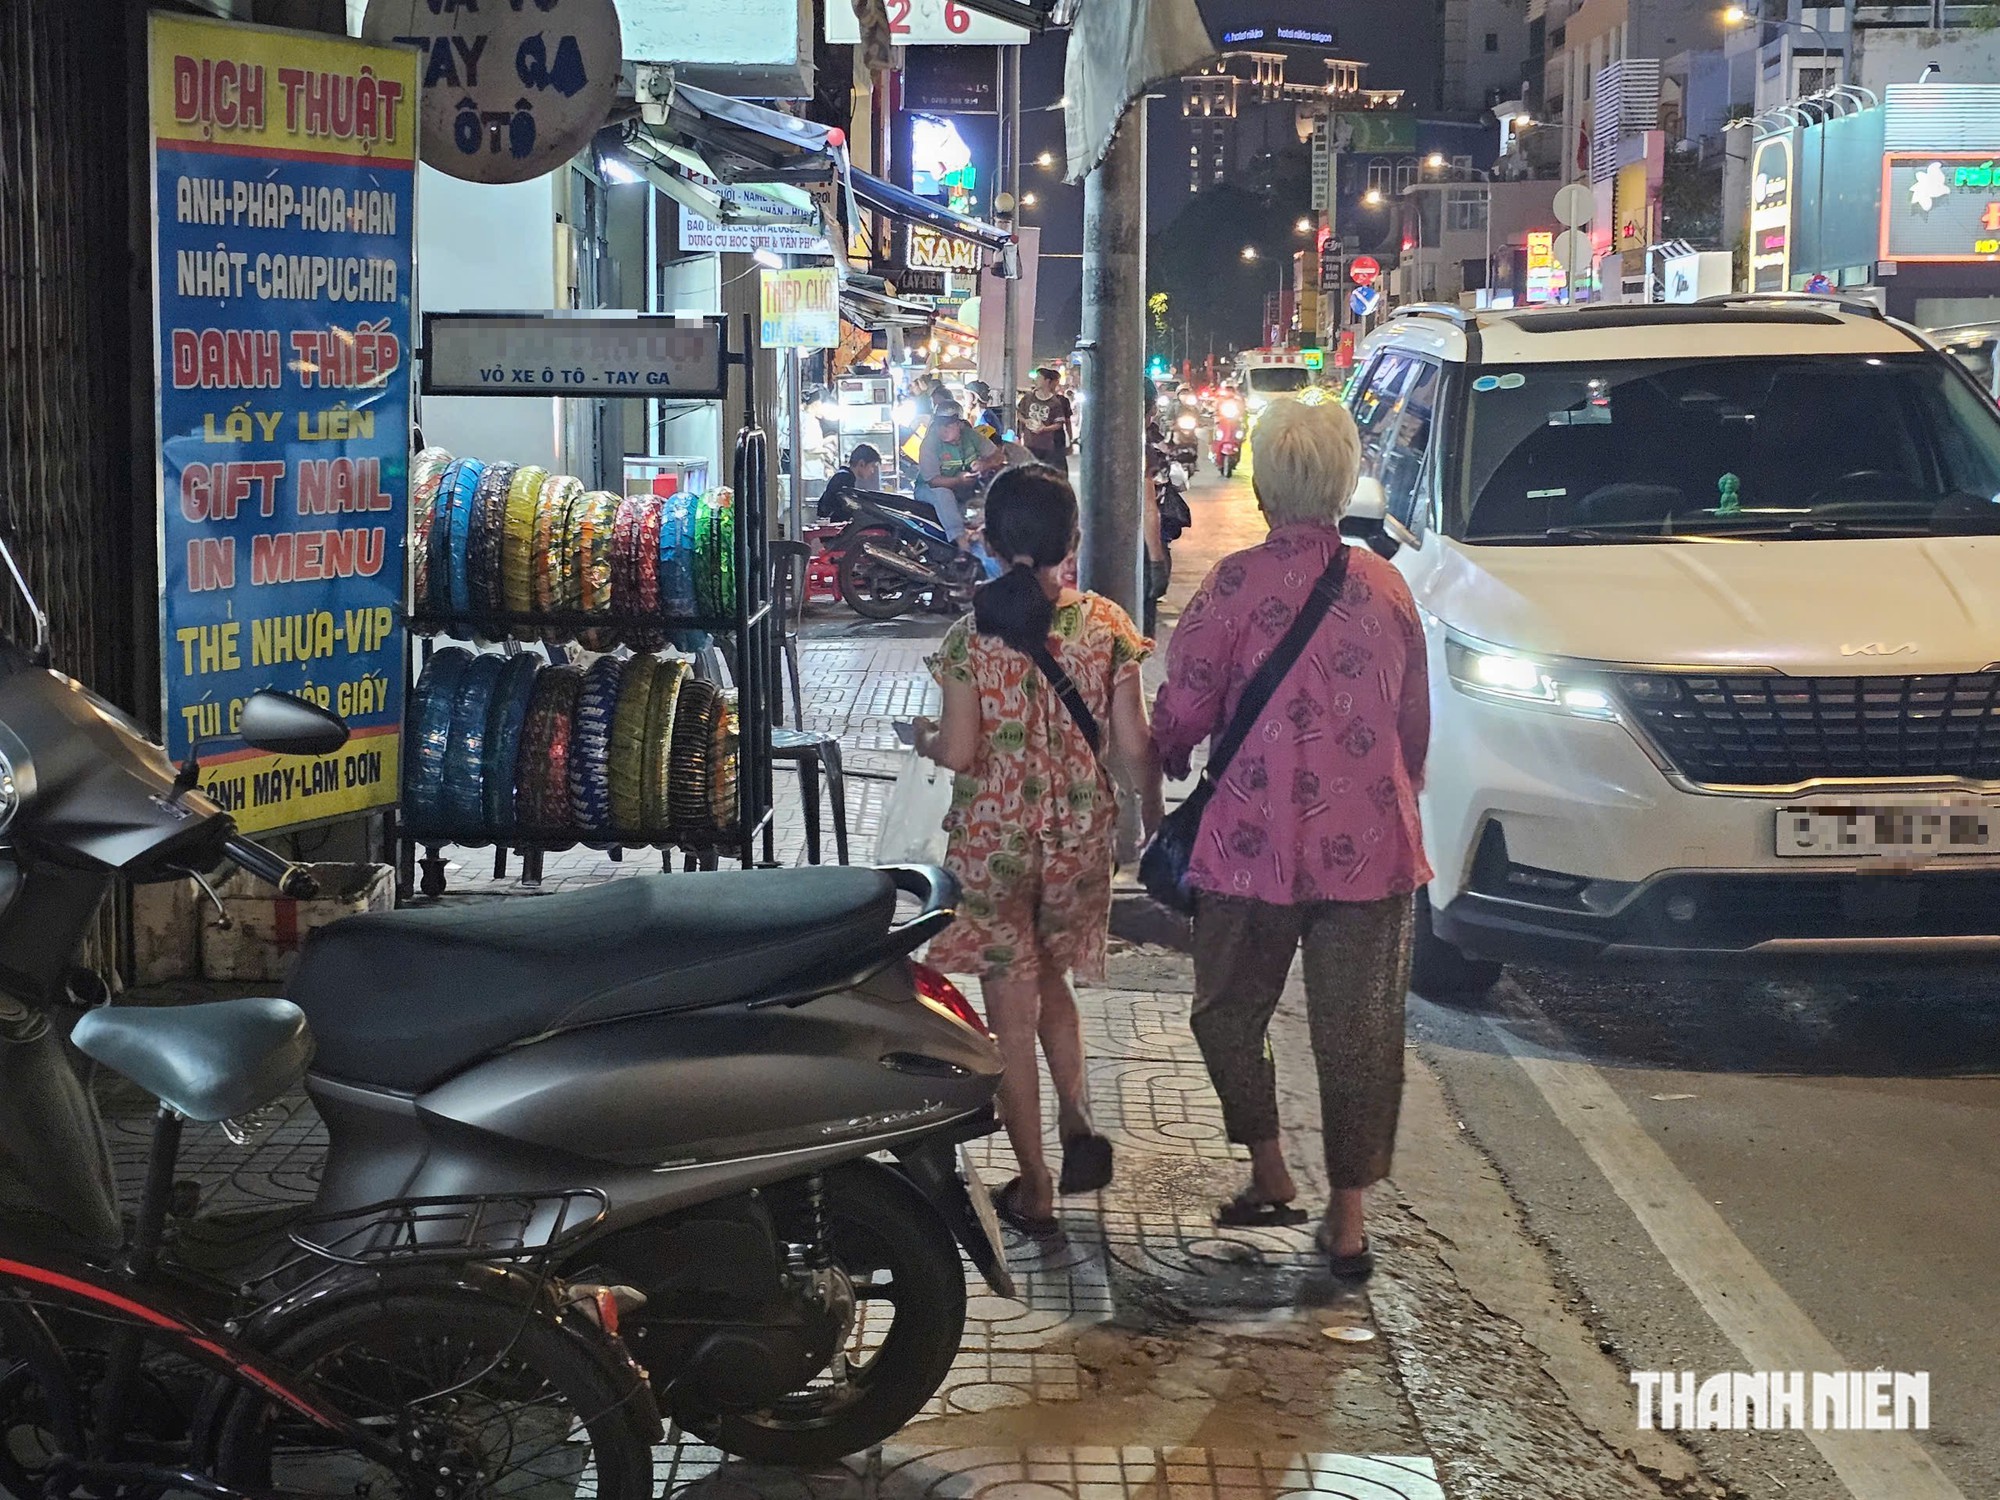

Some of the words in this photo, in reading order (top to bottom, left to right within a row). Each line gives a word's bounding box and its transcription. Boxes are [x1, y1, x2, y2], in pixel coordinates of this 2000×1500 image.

[173, 54, 266, 139] DỊCH
[278, 66, 402, 153] THUẬT
[171, 328, 281, 390] DANH
[291, 318, 400, 390] THIẾP
[480, 364, 504, 383] VỎ
[511, 369, 535, 383] XE
[541, 367, 555, 383] Ô
[560, 367, 585, 384] TÔ
[605, 371, 640, 385] TAY
[646, 371, 671, 385] GA
[203, 402, 283, 443] LẤY
[298, 400, 375, 440] LIỀN
[180, 460, 285, 523] GIFT
[296, 456, 392, 516] NAIL
[187, 535, 236, 592] IN
[252, 526, 385, 585] MENU
[1839, 642, 1919, 657] KIA
[181, 690, 221, 744] TÚI
[337, 668, 388, 718] GIẤY
[345, 750, 381, 788] ĐƠN
